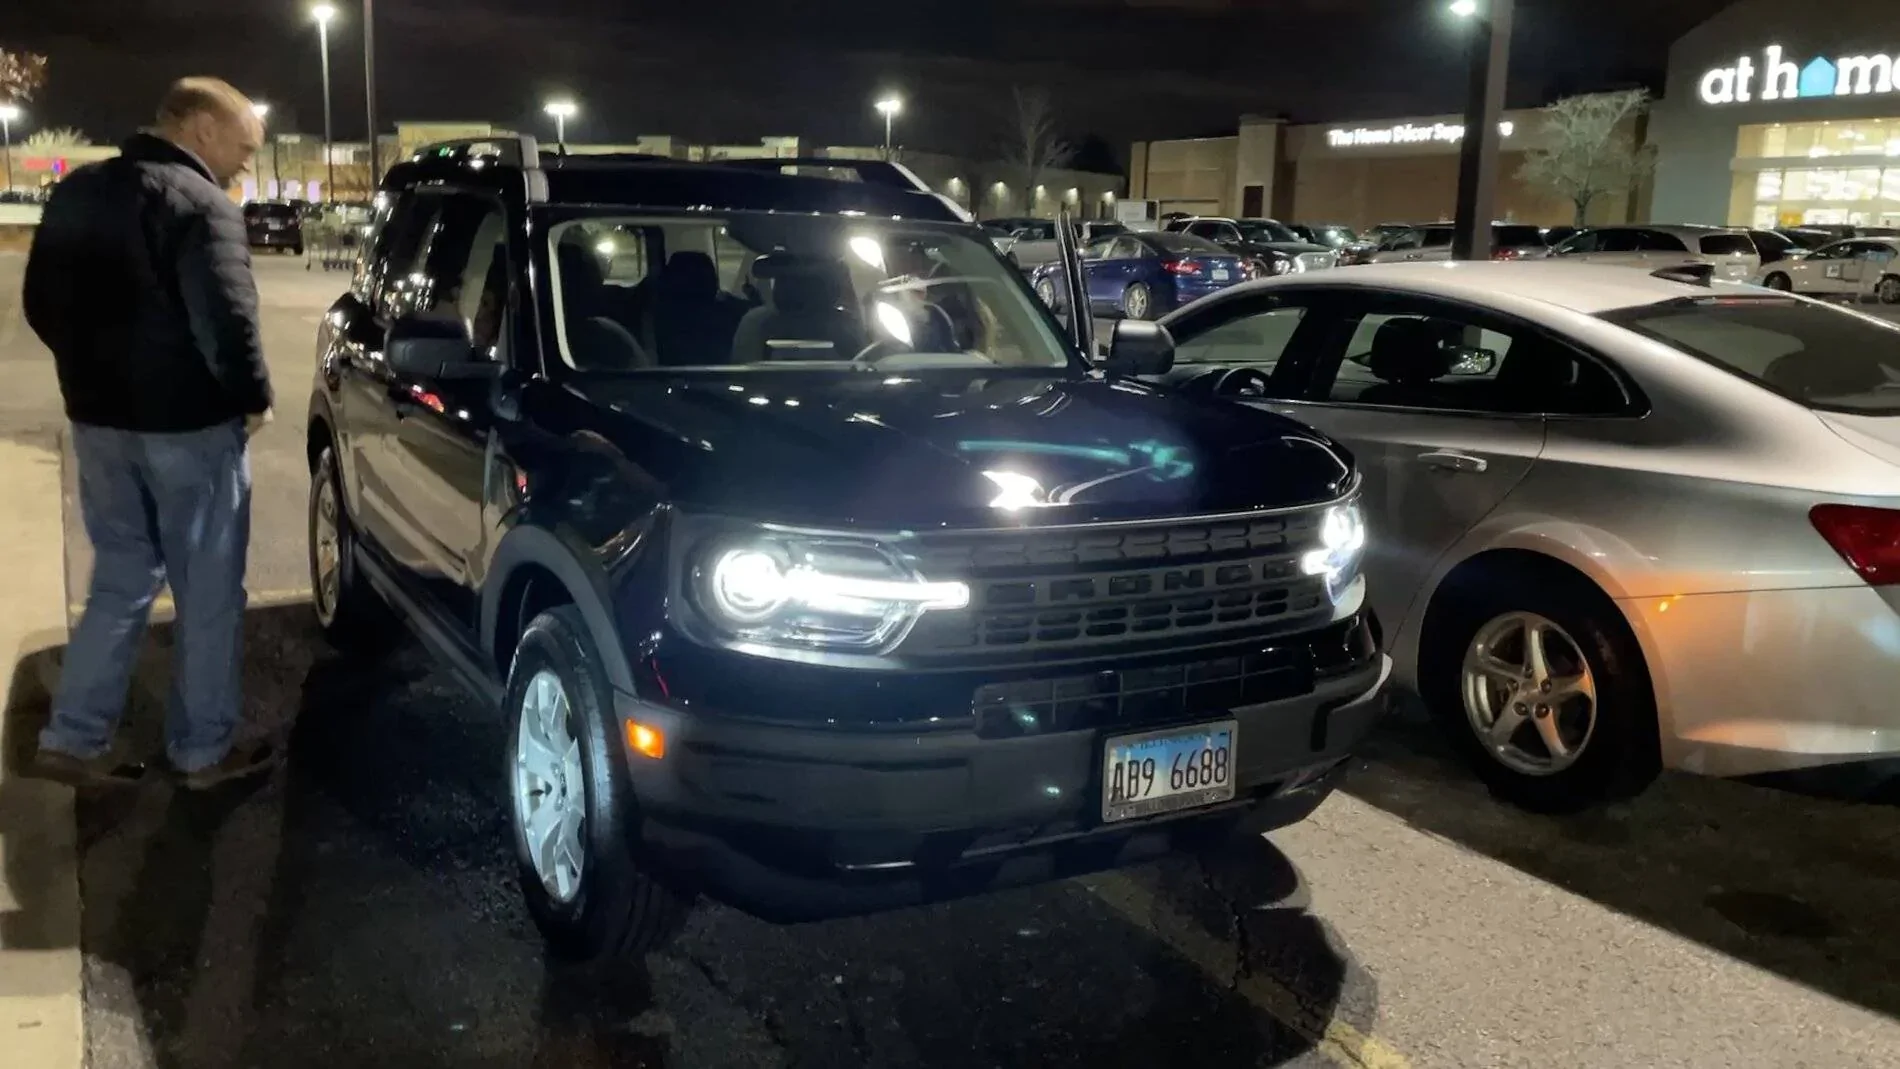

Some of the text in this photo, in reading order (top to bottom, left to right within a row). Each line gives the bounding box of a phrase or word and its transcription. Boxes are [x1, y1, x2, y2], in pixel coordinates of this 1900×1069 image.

[1699, 56, 1754, 104] at
[1328, 129, 1354, 146] The
[1110, 757, 1156, 804] AB9
[1169, 746, 1228, 791] 6688
